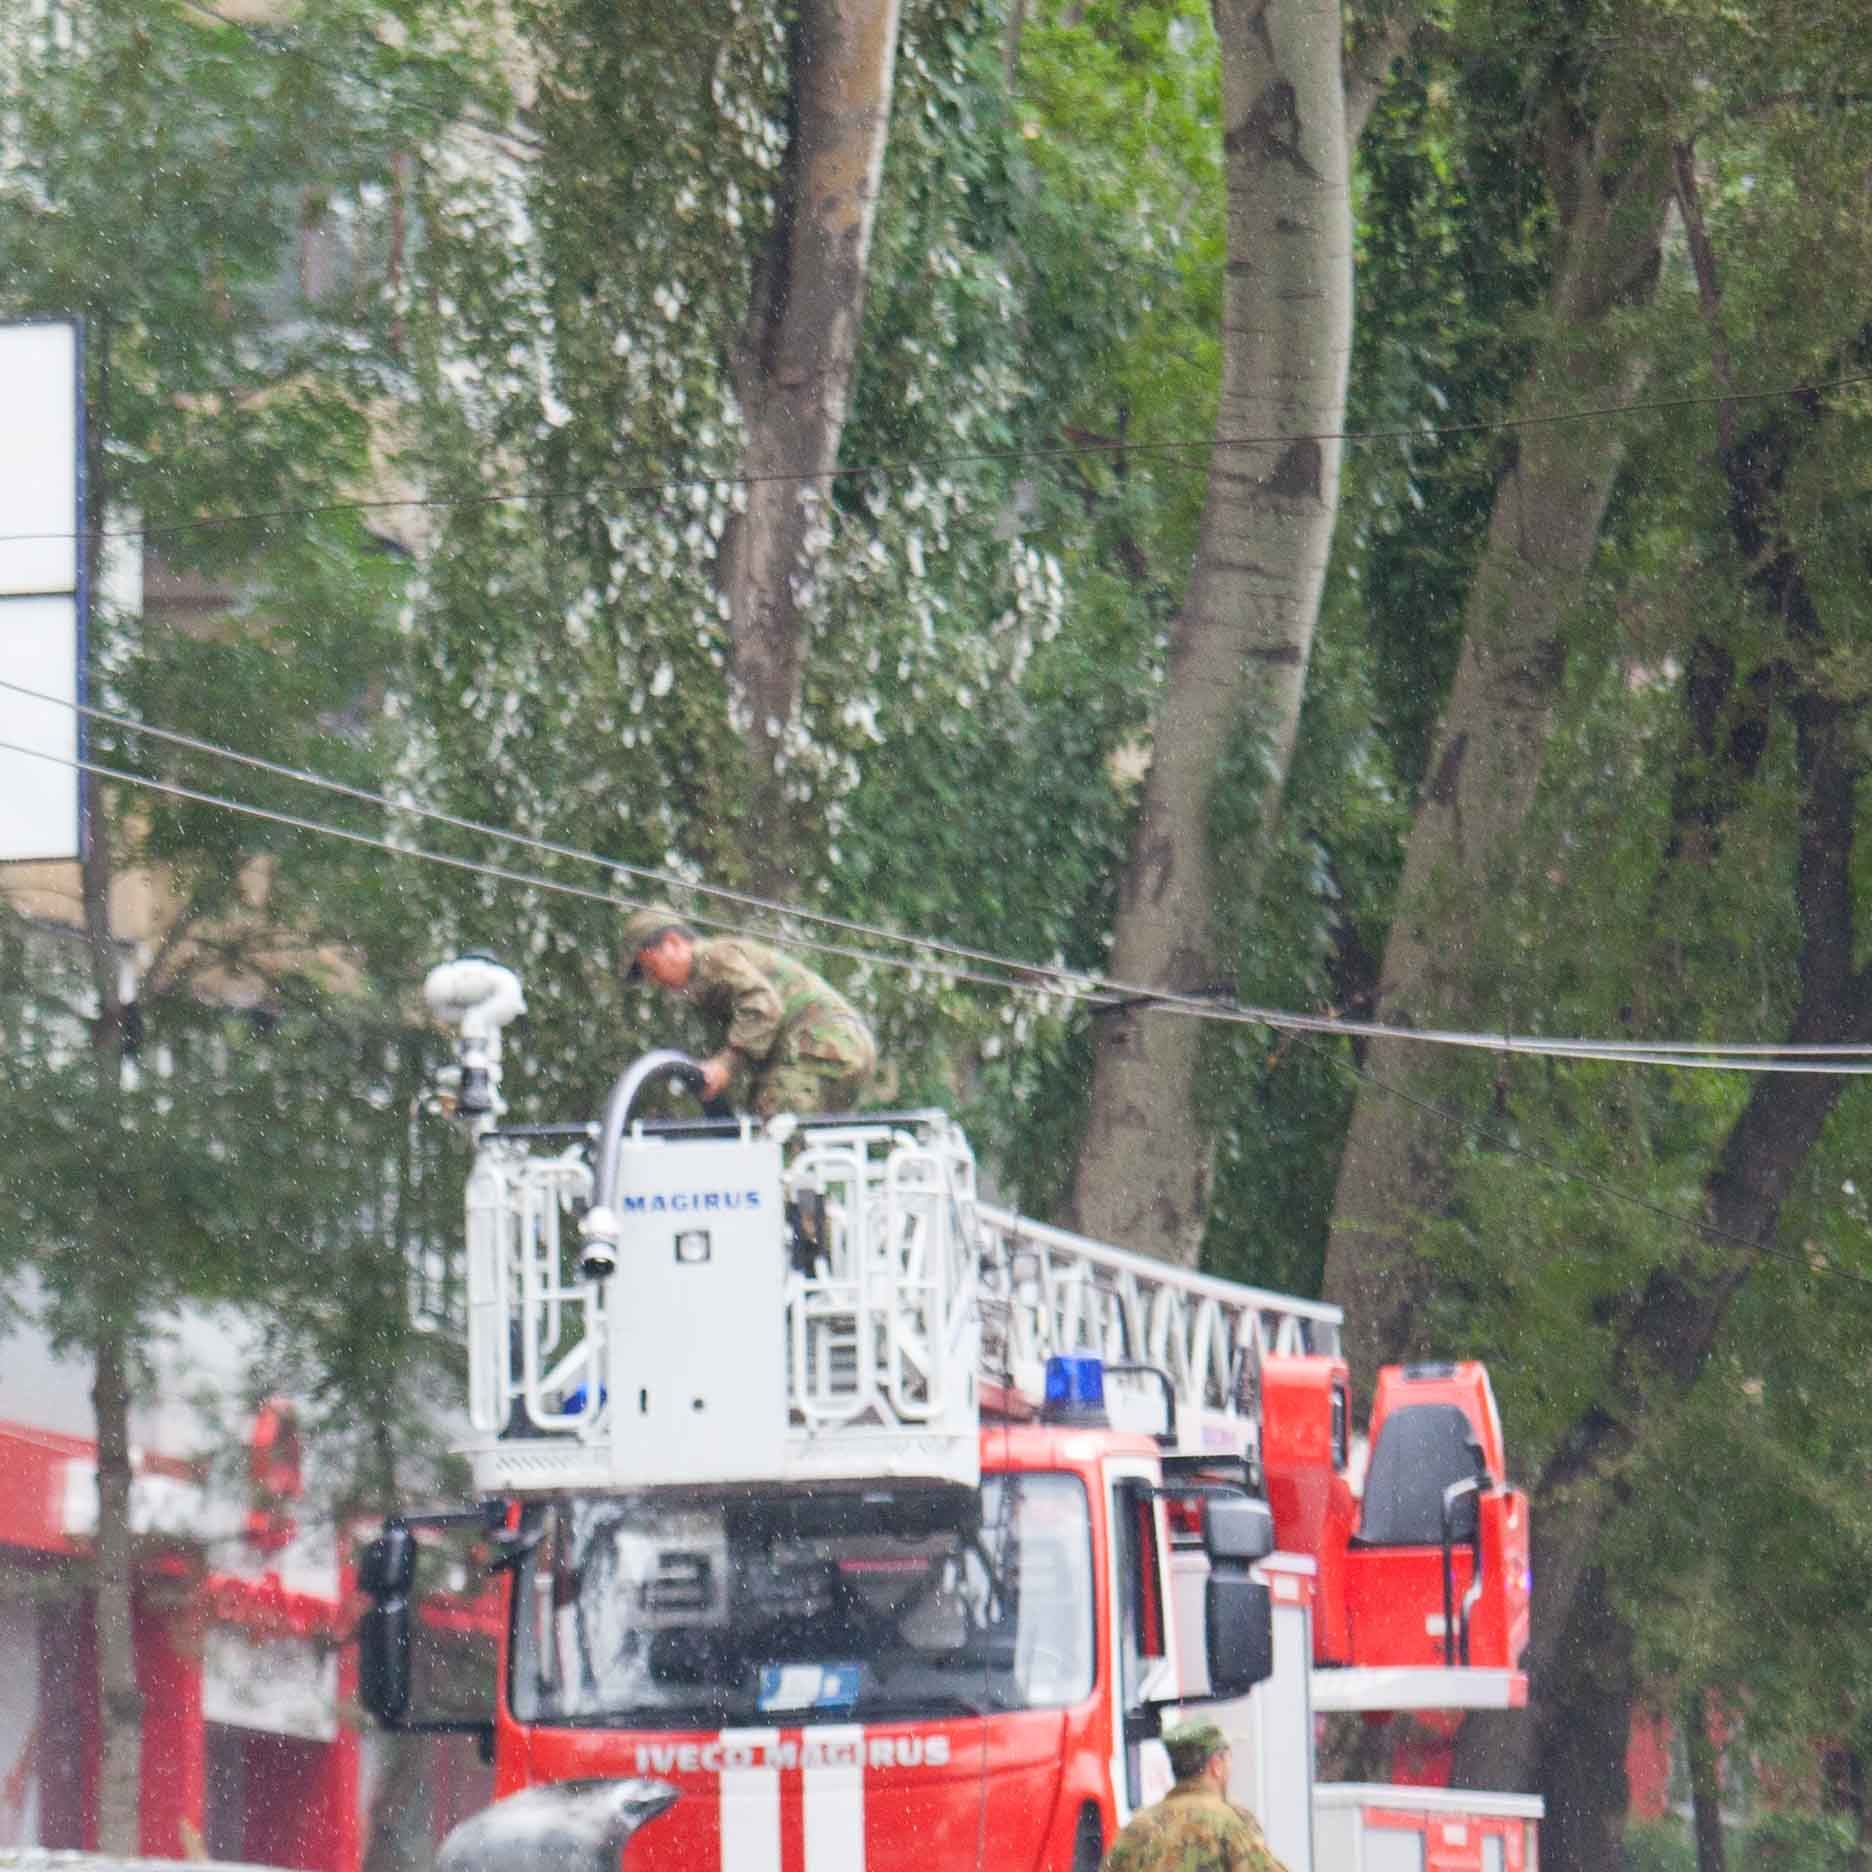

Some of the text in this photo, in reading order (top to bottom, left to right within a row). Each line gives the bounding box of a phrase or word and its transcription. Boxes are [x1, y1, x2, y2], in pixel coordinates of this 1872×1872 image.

[623, 1190, 761, 1212] MAGIRUS
[635, 1735, 952, 1773] IVECO MAGIRUS
